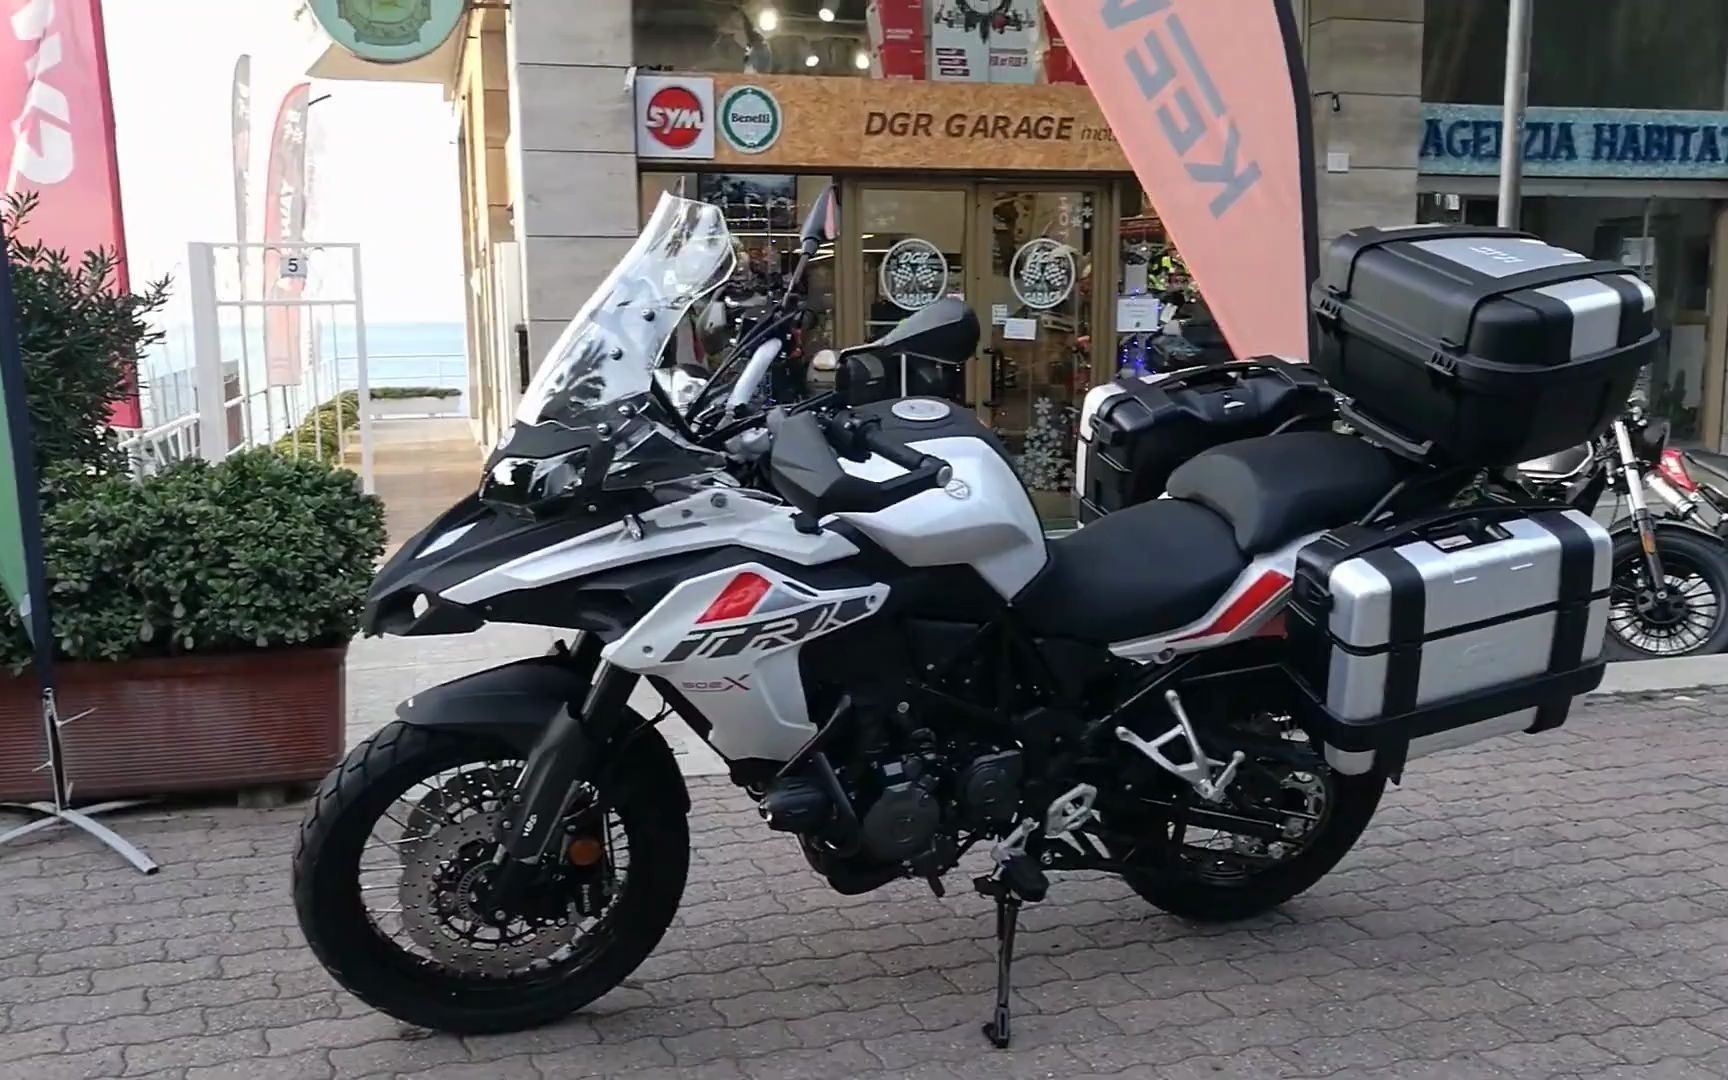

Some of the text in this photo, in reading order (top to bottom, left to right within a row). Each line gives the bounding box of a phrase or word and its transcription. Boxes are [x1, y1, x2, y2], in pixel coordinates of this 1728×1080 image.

[646, 105, 704, 135] SYM
[731, 112, 770, 124] Benelli
[864, 111, 1117, 142] DGR GARAGE mot
[288, 258, 298, 272] 5
[684, 600, 846, 661] TRK
